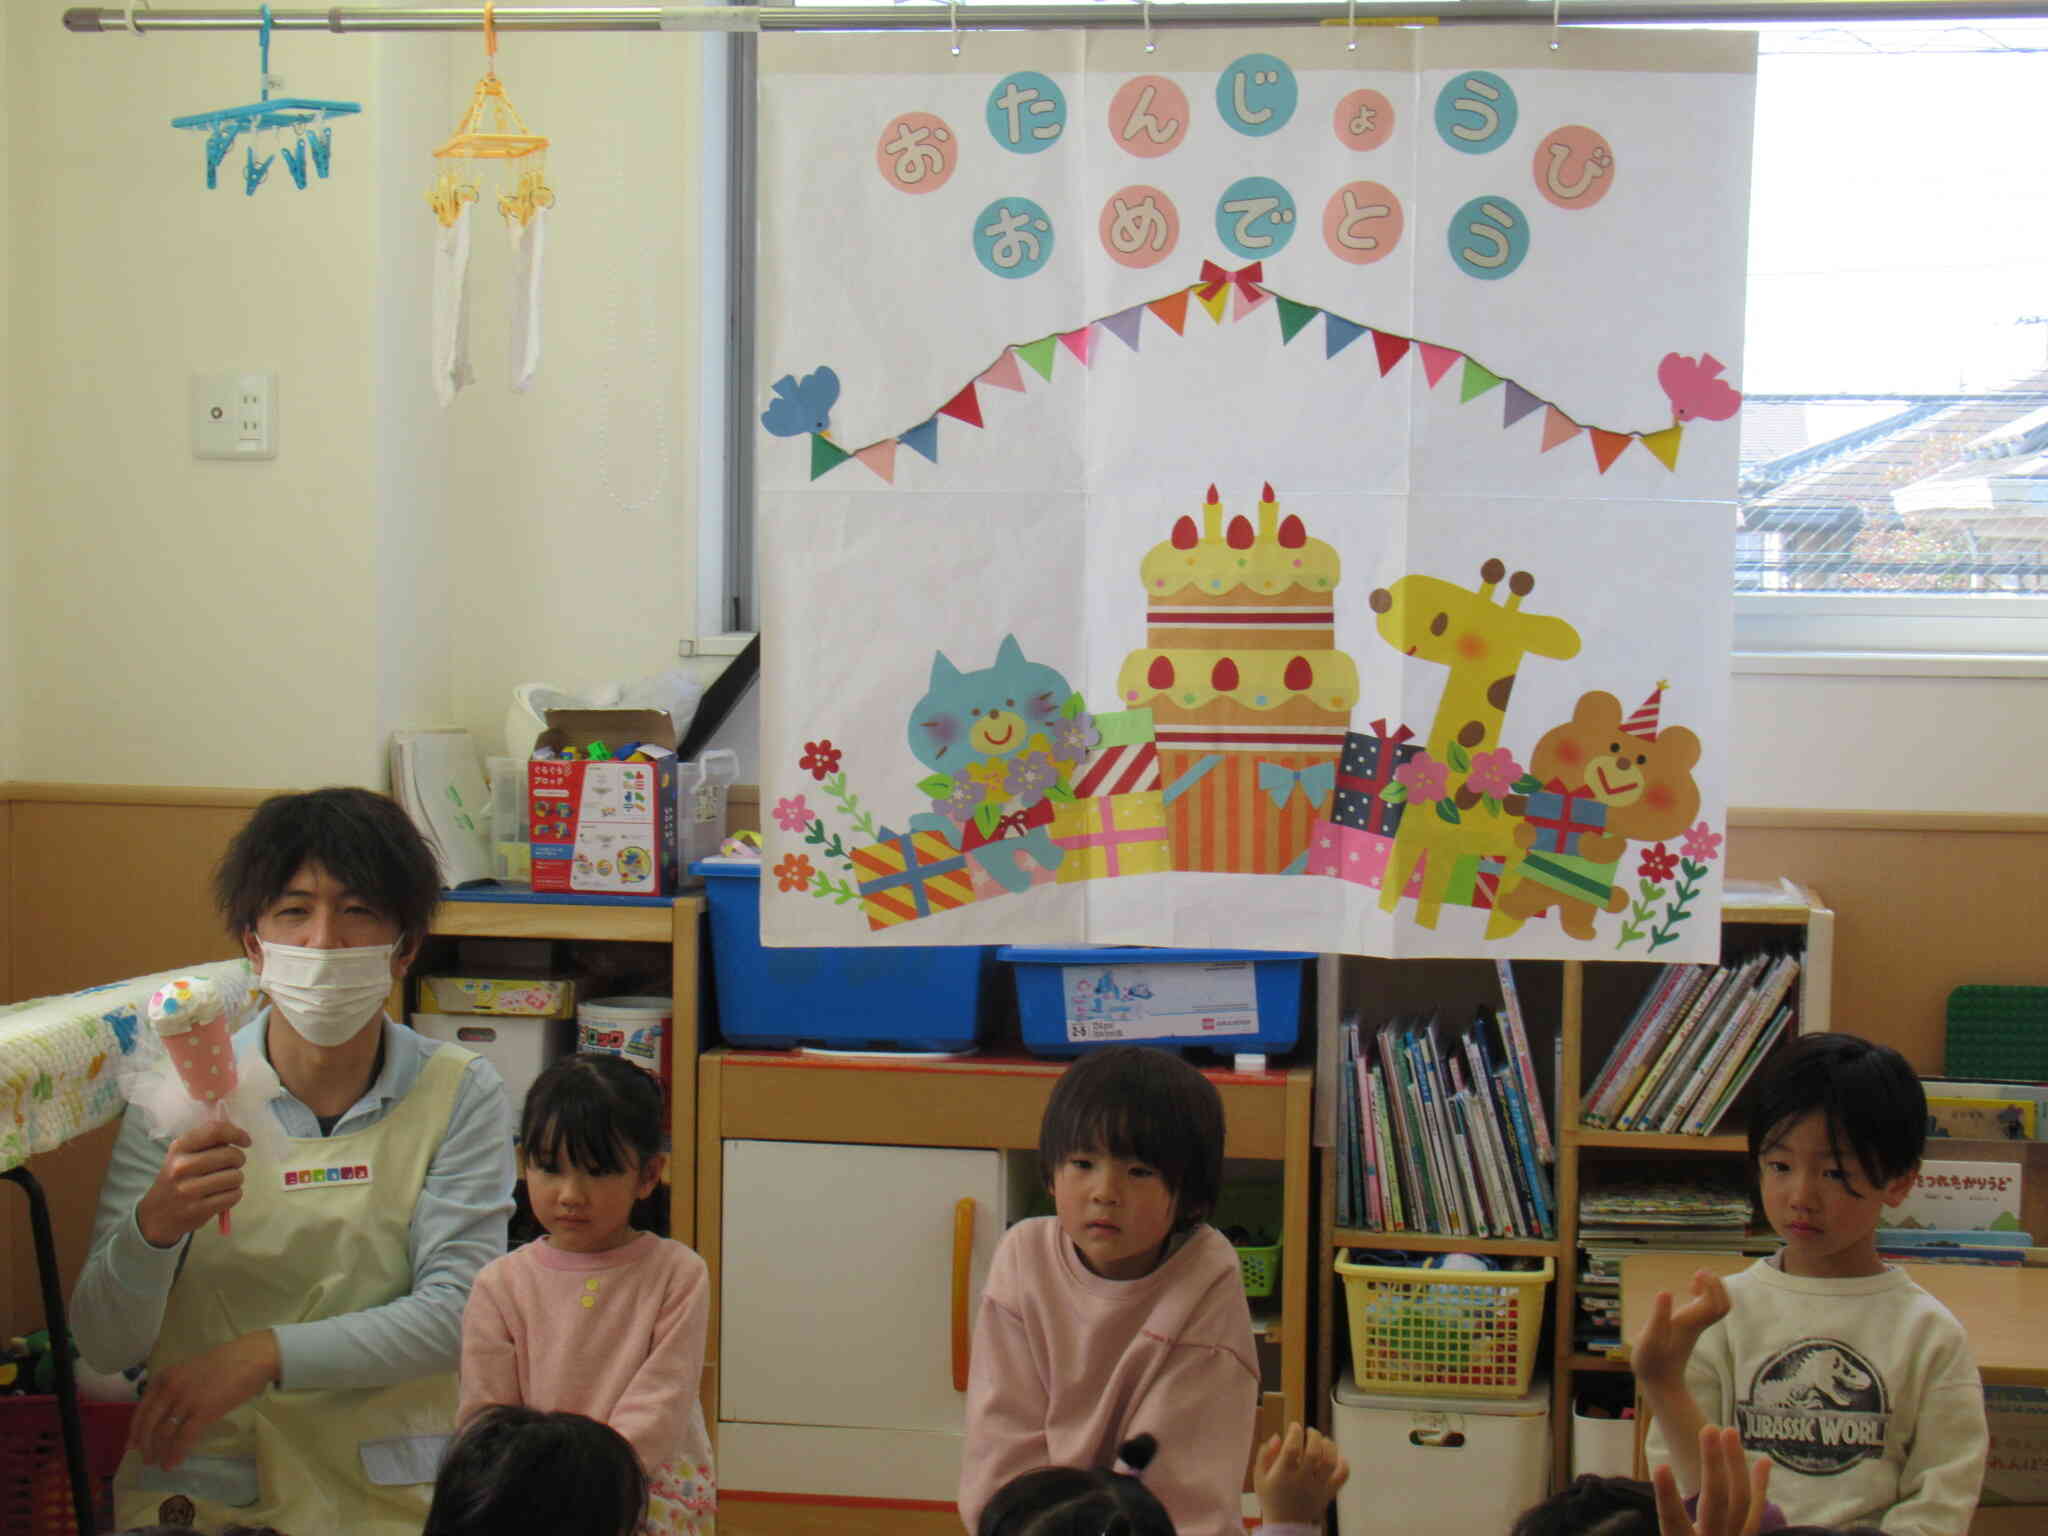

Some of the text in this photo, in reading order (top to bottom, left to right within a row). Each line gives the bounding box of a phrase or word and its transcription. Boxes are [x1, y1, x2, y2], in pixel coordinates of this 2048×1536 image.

[884, 69, 1613, 199] おたんじょうび
[984, 191, 1514, 269] おめでとう
[1743, 1411, 1888, 1447] JURASSIC WORL
